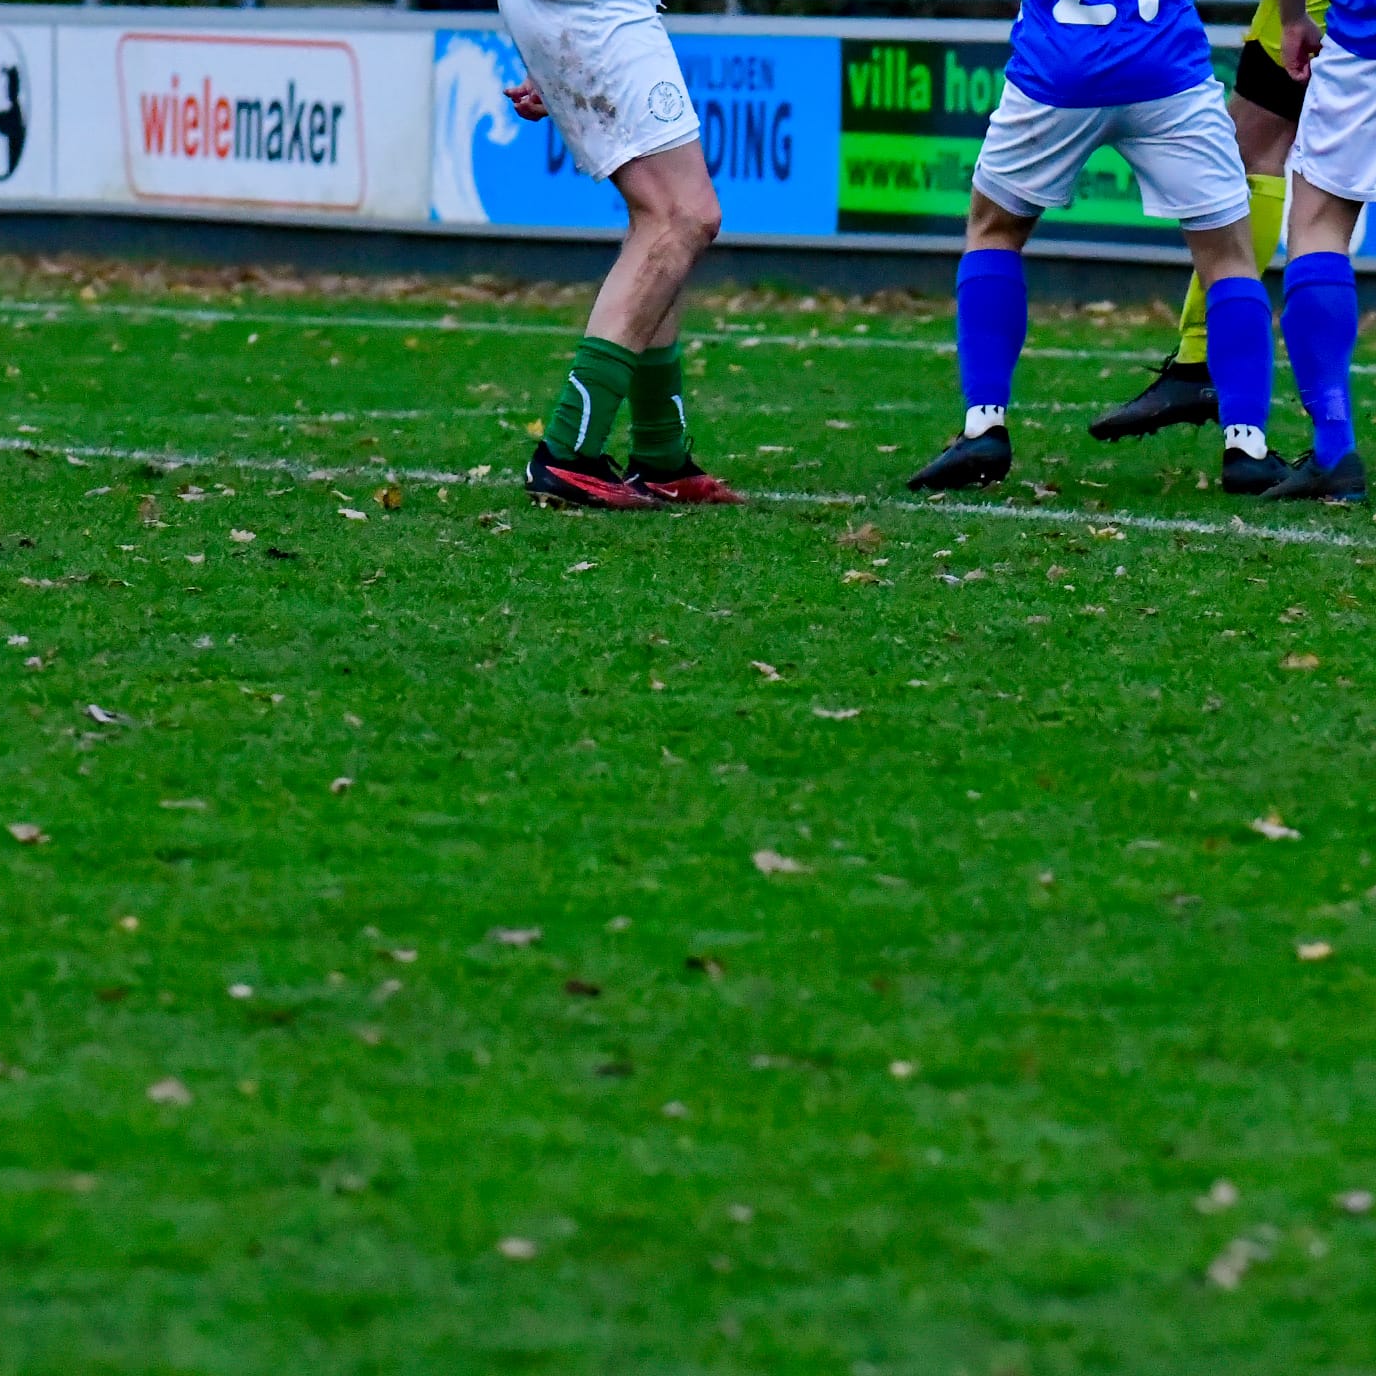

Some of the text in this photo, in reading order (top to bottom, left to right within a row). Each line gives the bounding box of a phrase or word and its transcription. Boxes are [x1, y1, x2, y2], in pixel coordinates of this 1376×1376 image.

[683, 54, 775, 92] VILJOEN
[847, 47, 932, 111] villa
[140, 73, 345, 165] wielemaker
